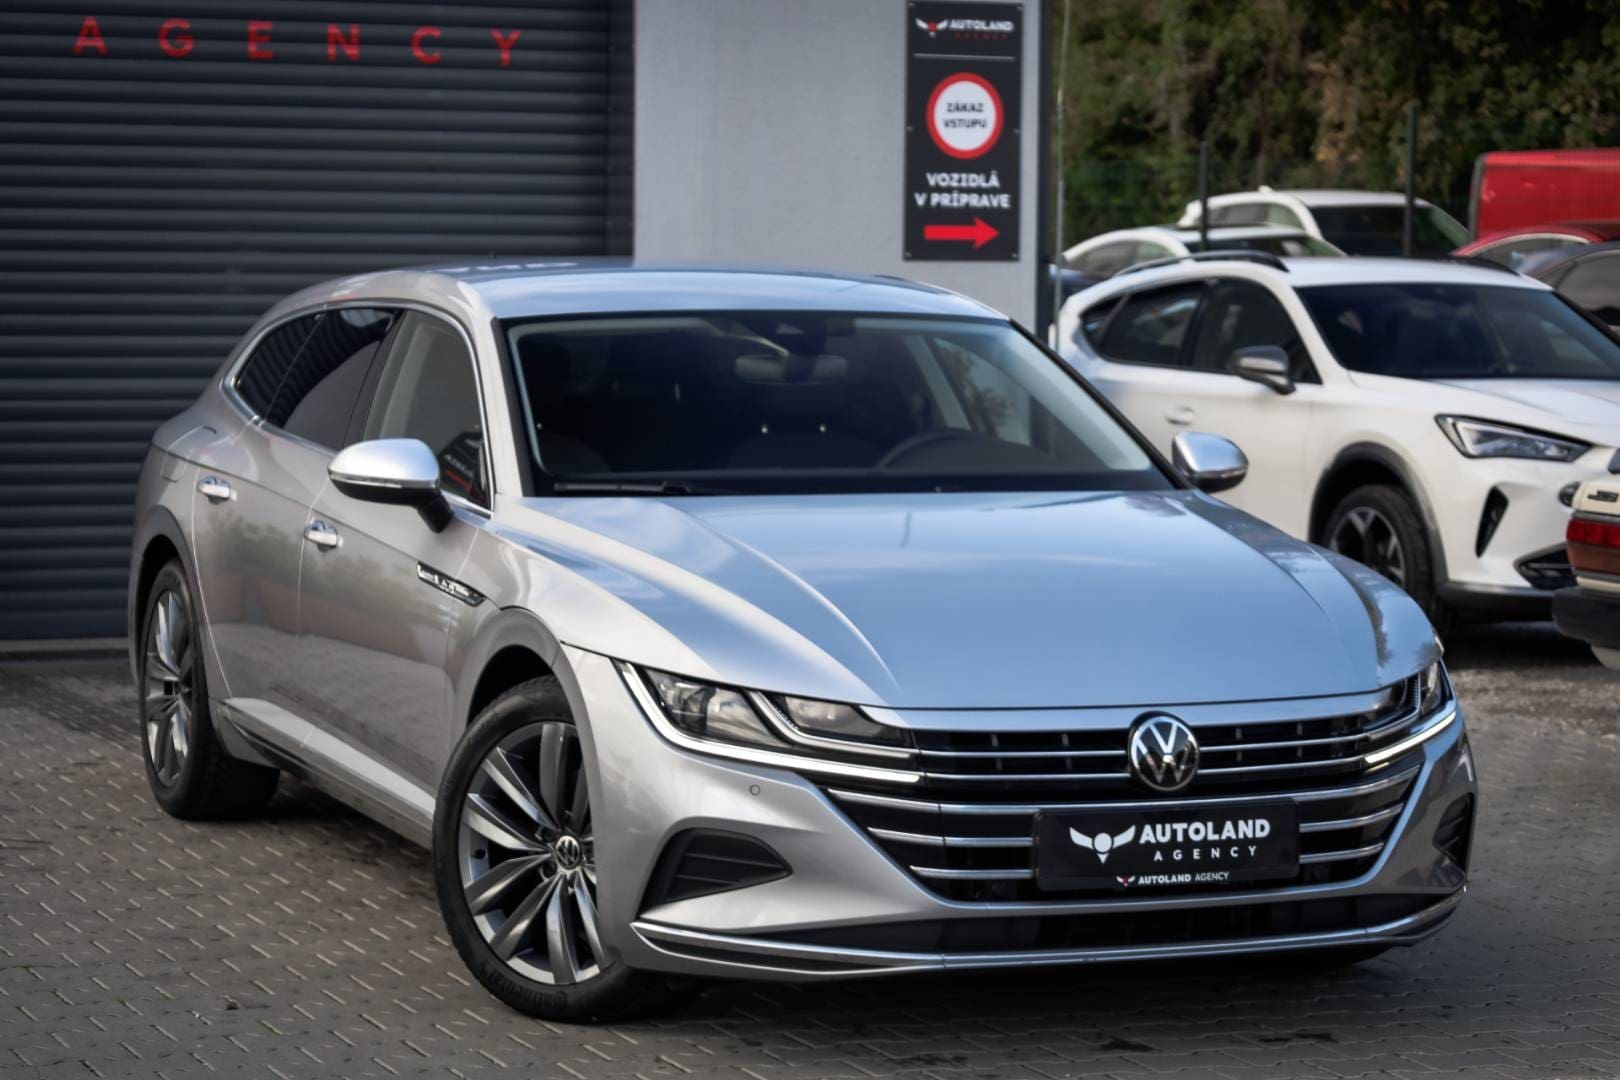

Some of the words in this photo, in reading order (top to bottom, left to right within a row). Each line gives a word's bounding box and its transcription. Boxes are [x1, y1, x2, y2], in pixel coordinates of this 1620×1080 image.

[949, 19, 1014, 31] AUTOLAND
[73, 16, 521, 66] AGENCY
[943, 118, 987, 129] VSTUPU
[926, 170, 1000, 188] VOZIDLÁ
[914, 192, 928, 208] V
[1139, 818, 1271, 845] AUTOLAND
[1153, 846, 1257, 862] AGENCY
[1138, 873, 1191, 885] AUTOLAND
[1194, 872, 1230, 882] AGENCY
